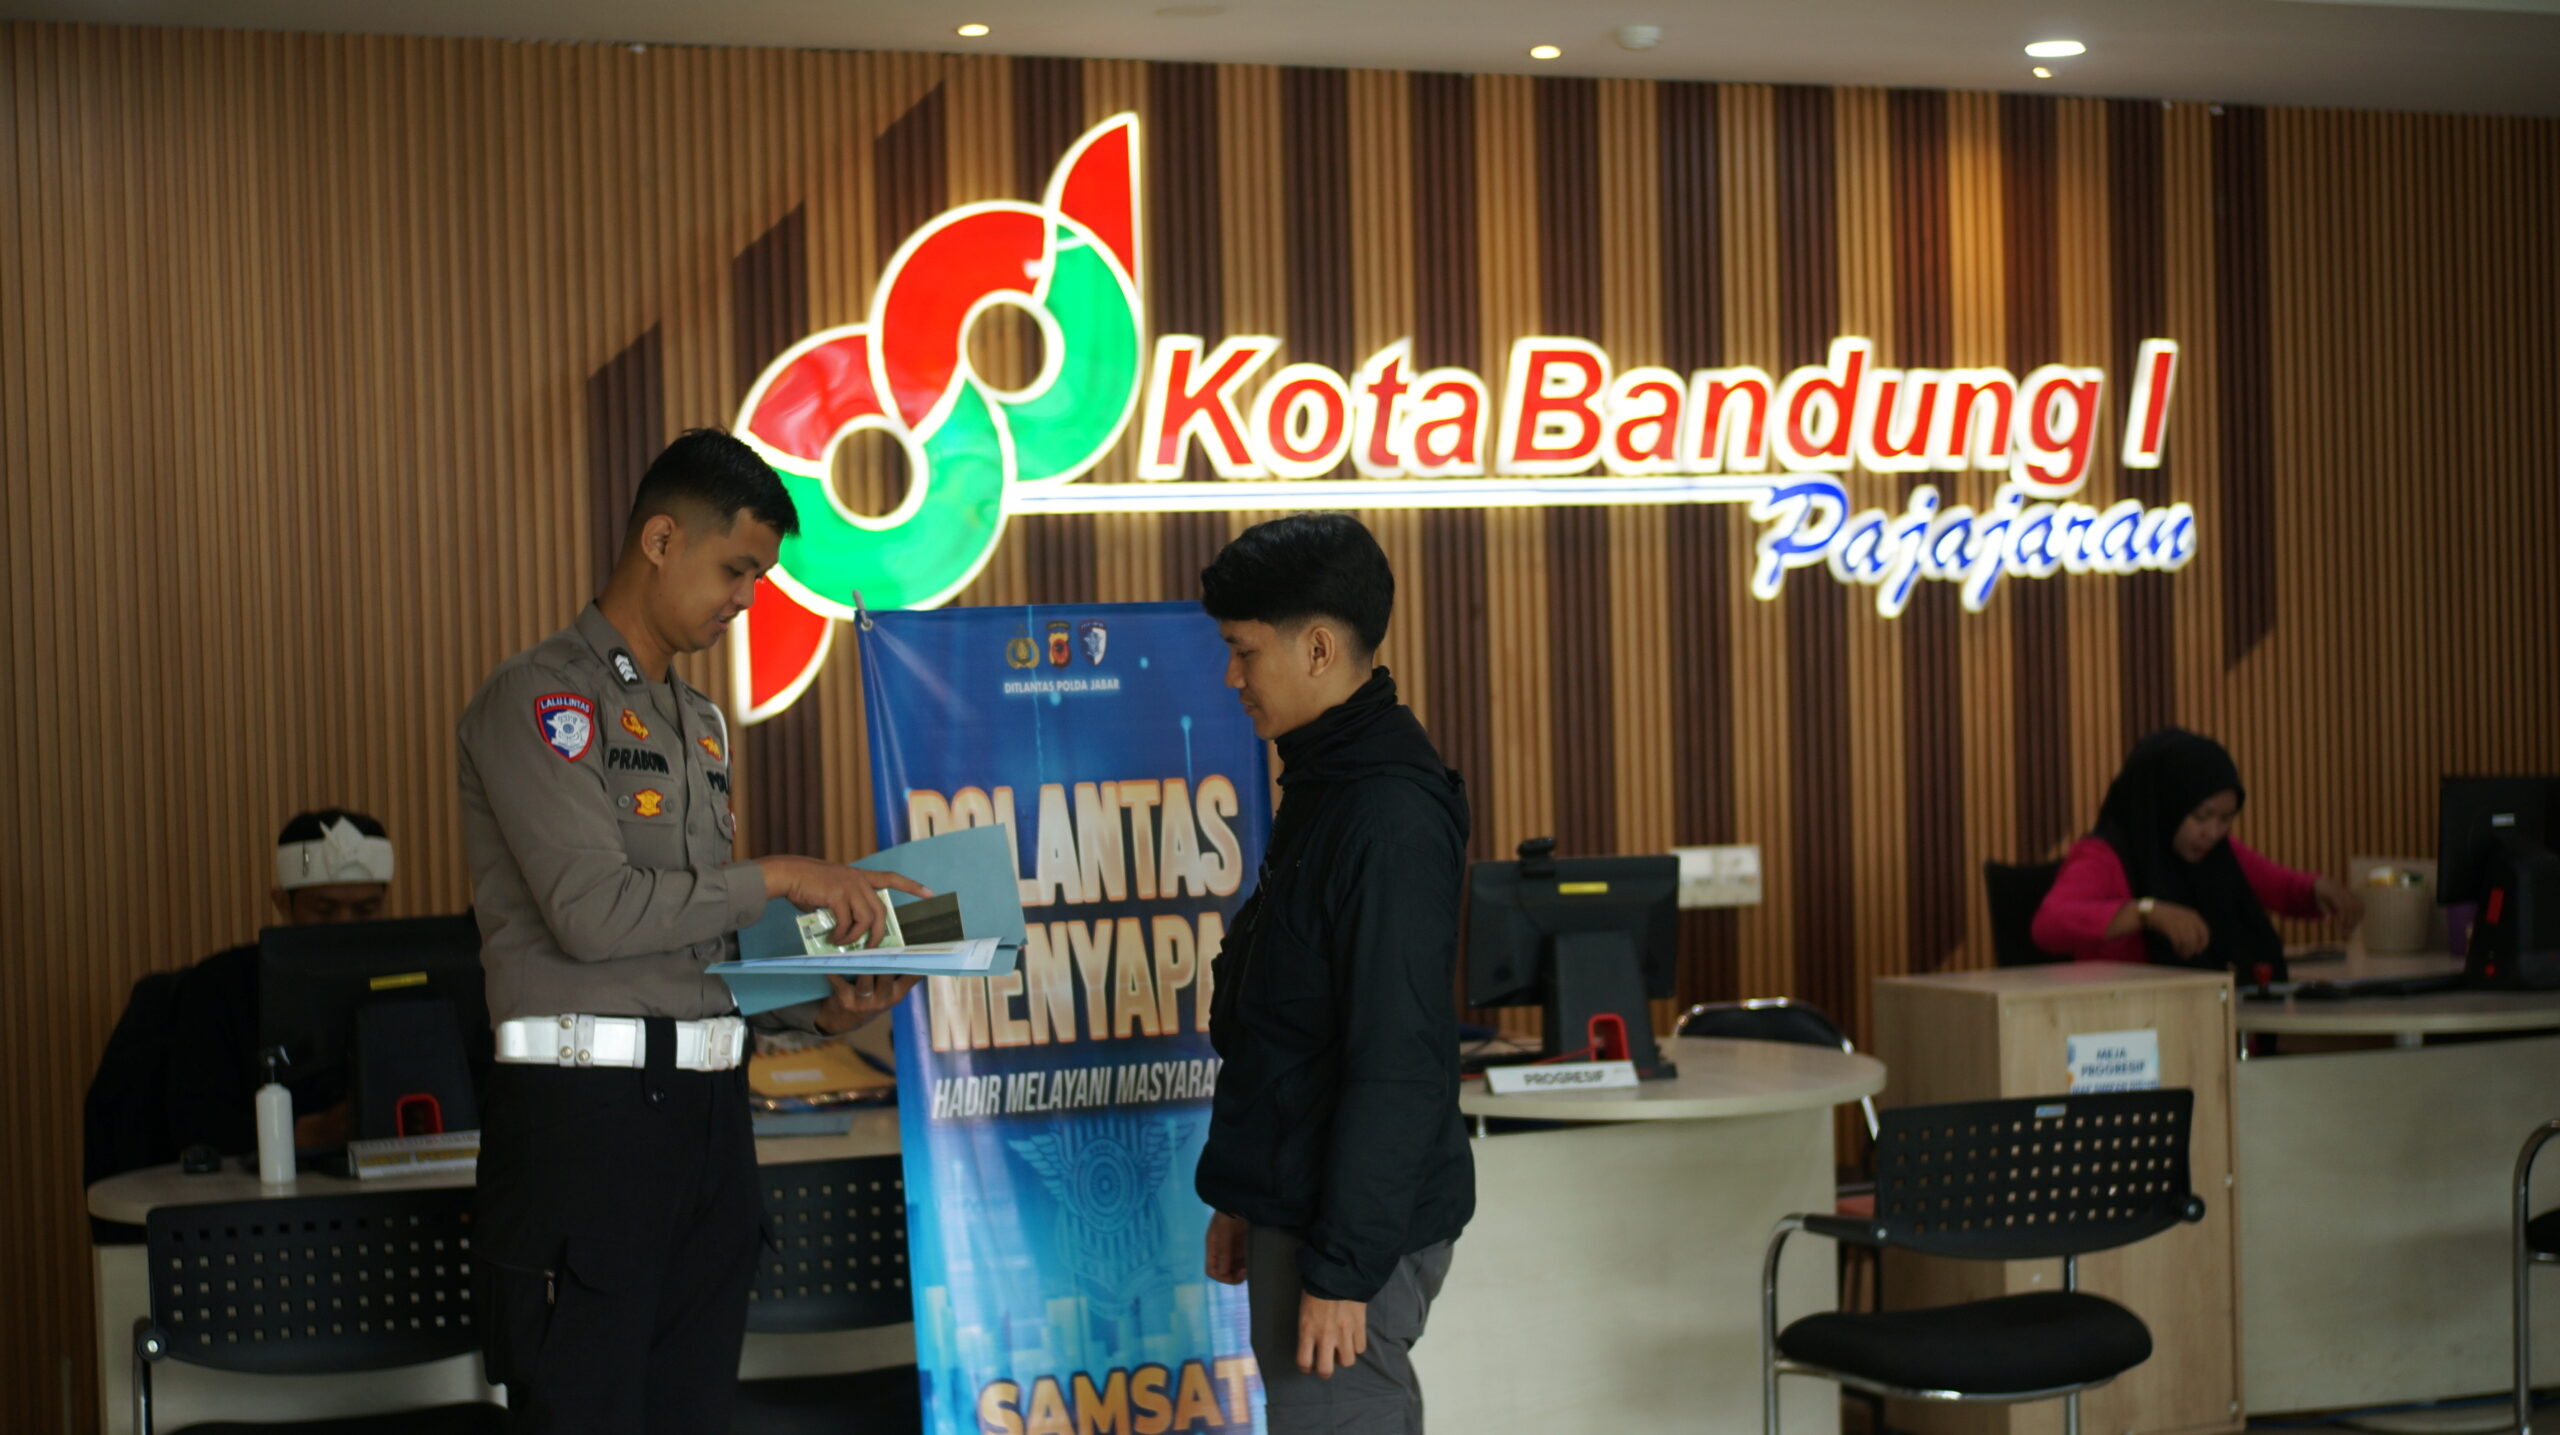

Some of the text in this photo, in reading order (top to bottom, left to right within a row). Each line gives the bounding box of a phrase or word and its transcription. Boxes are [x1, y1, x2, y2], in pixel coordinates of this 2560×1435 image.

[1142, 336, 2178, 495] Kota Bandung I
[1752, 476, 2195, 615] Pajajaran
[1004, 678, 1120, 694] DITLANTAS POLDA JABAR
[541, 697, 590, 713] LALU LINTAS
[2096, 1047, 2127, 1061] MEJA
[931, 1074, 1001, 1119] HADIR
[1005, 1066, 1112, 1113] MELAYANI
[1523, 1069, 1605, 1086] PROGRESIF
[978, 1354, 1257, 1435] SAMSAT
